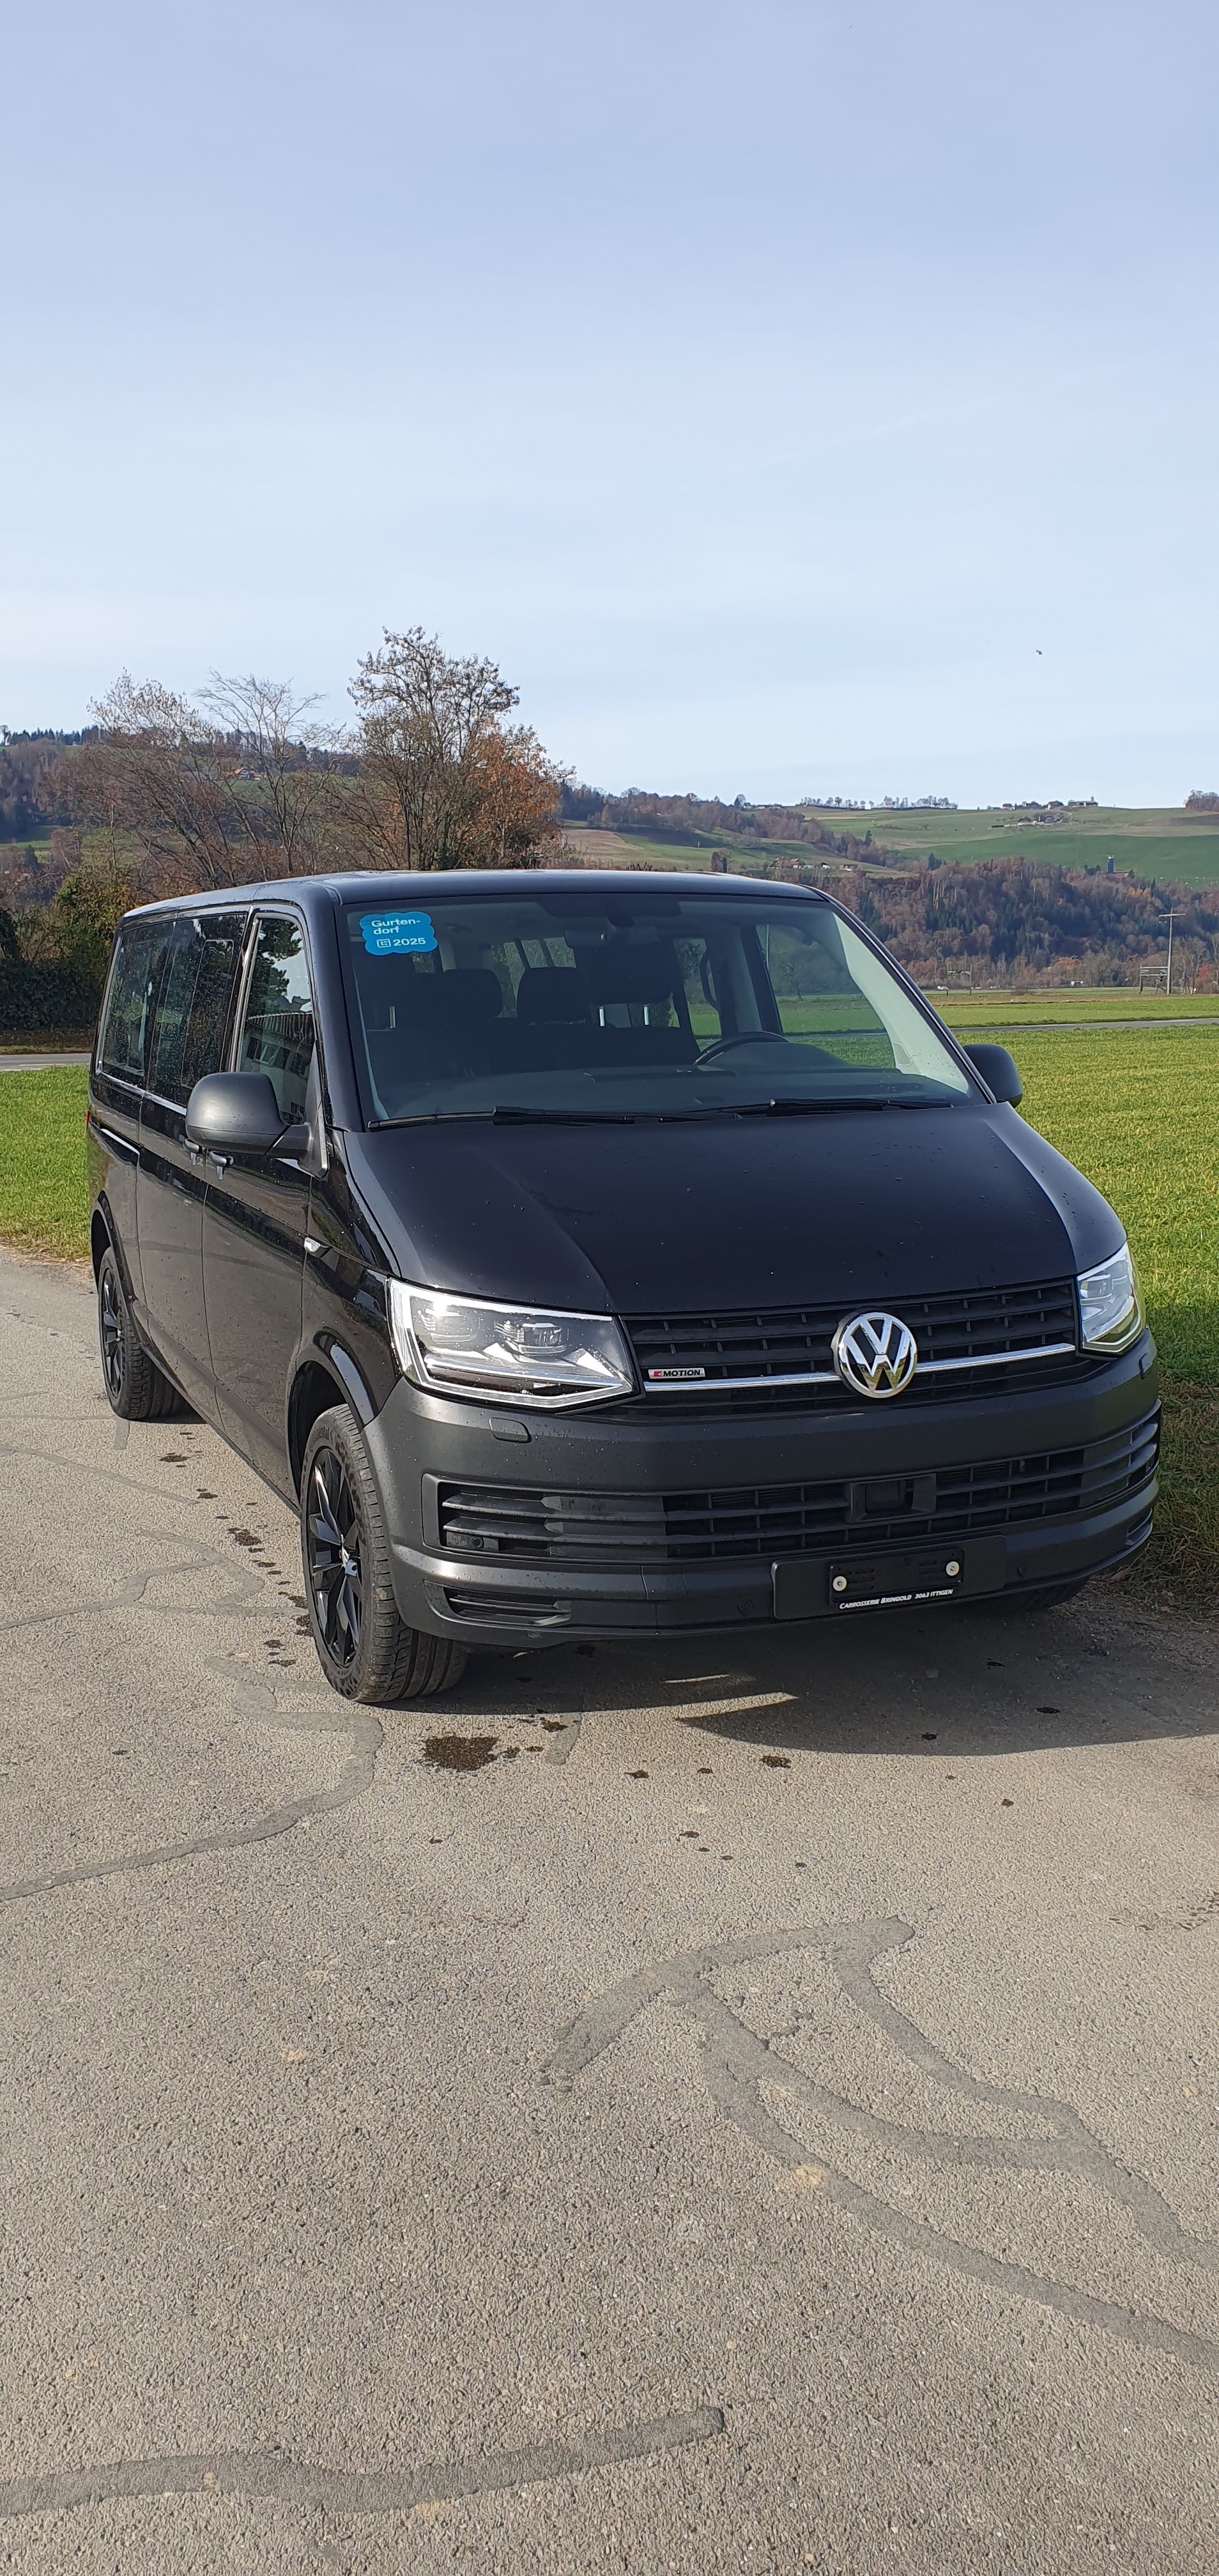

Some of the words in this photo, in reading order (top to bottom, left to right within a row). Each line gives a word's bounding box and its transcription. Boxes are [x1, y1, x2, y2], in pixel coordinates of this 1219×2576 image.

[371, 919, 420, 927] Gurten-
[373, 926, 399, 935] dorf
[393, 937, 426, 946] 2025
[839, 1311, 917, 1398] VW
[930, 1589, 953, 1597] ITTIGEN
